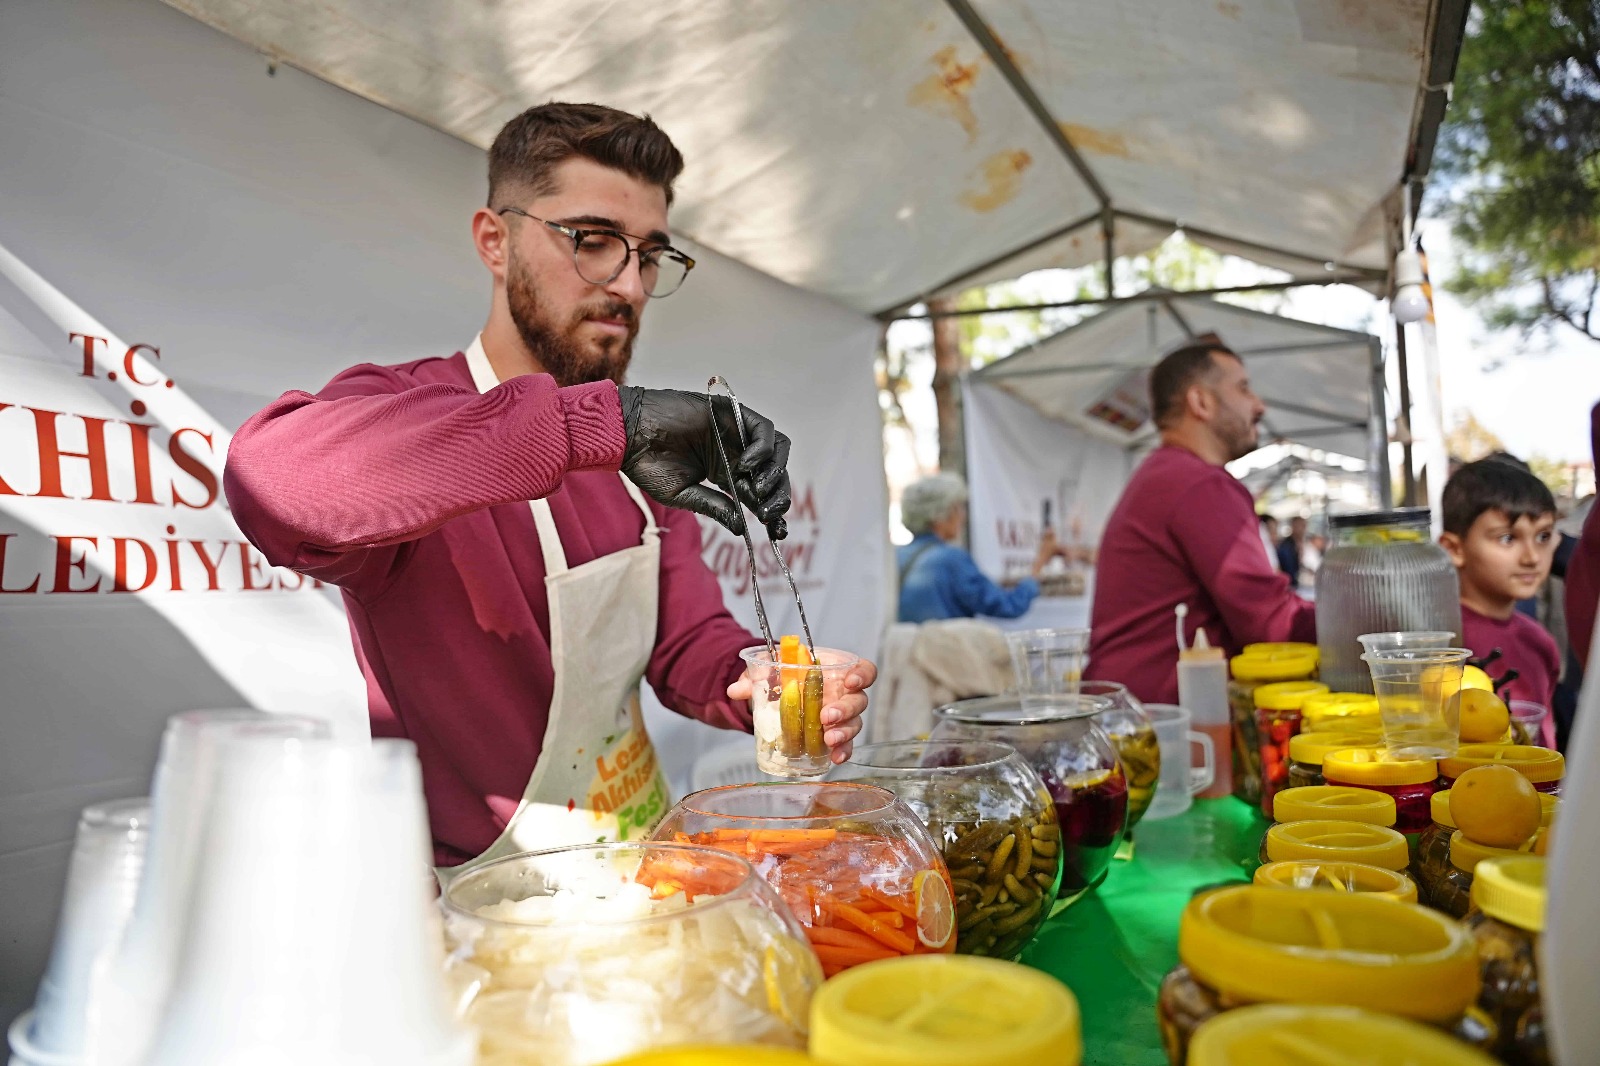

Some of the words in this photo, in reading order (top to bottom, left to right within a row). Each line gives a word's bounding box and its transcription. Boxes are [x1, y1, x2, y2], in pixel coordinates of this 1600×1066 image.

[69, 332, 174, 388] T.C.
[0, 399, 218, 510] HİS
[0, 525, 324, 594] LEDİYE
[591, 752, 655, 821] Akhis
